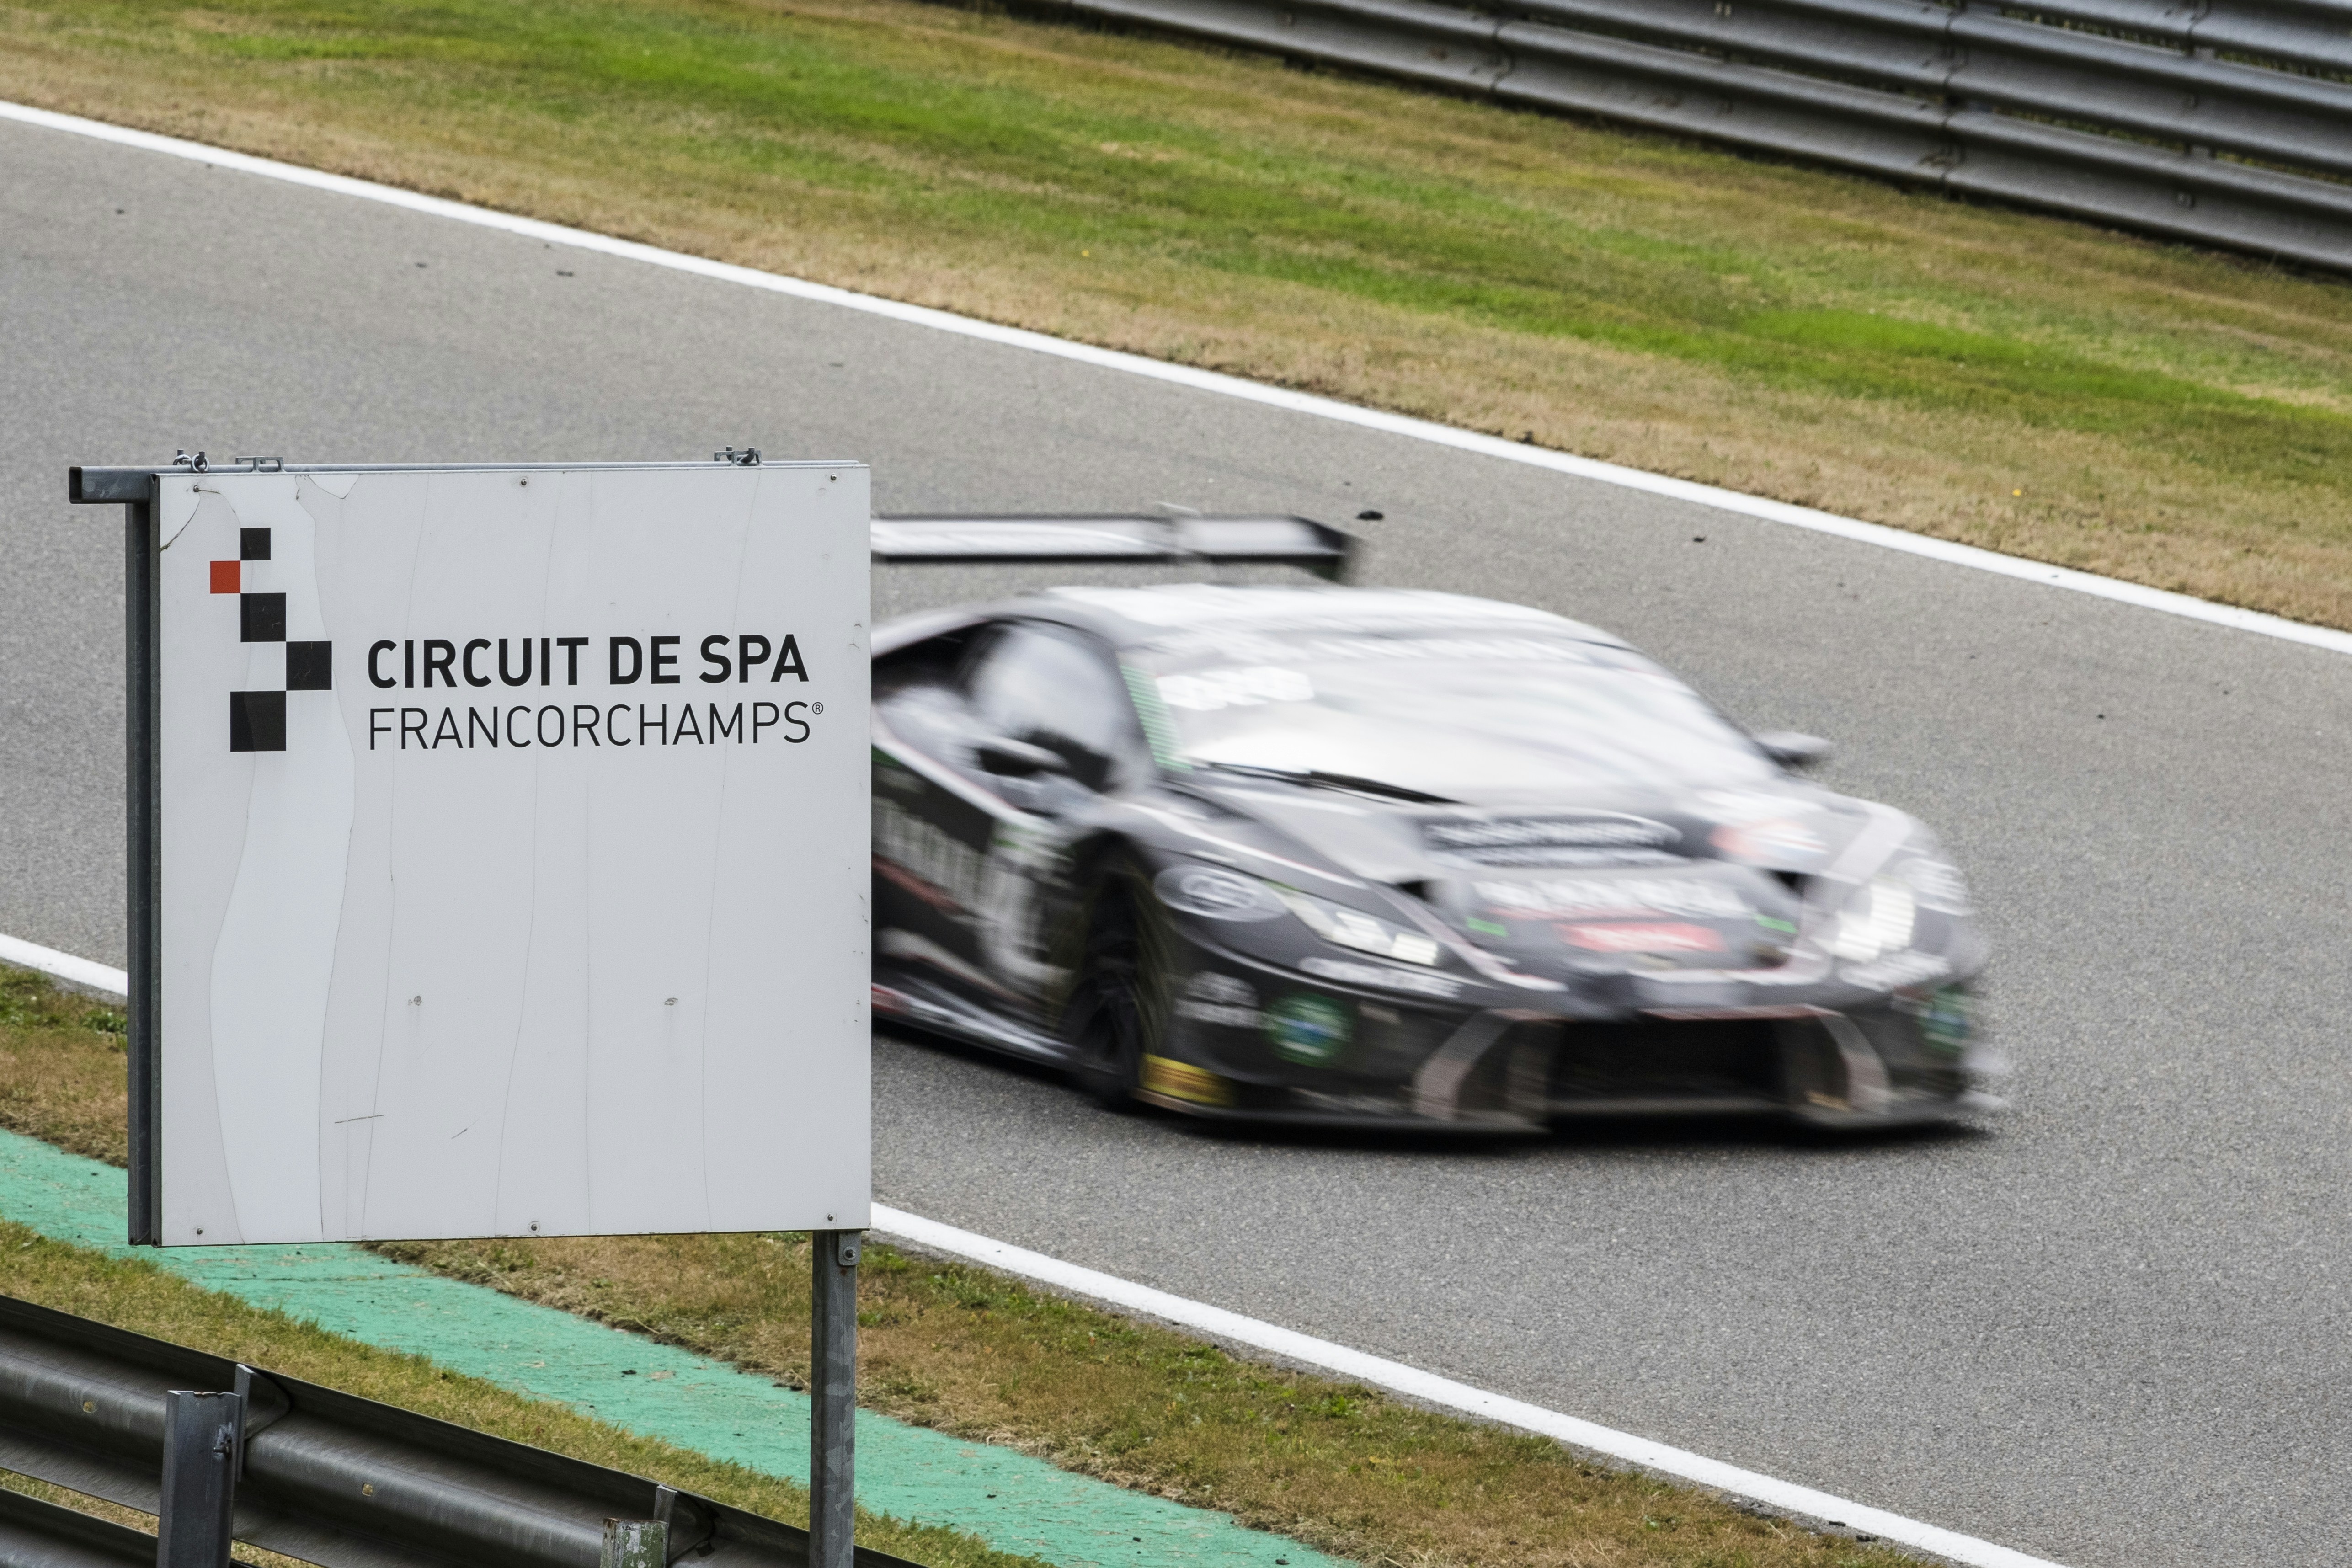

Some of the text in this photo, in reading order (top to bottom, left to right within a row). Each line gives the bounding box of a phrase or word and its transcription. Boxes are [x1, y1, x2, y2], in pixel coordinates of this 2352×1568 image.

[368, 634, 810, 689] CIRCUIT DE SPA
